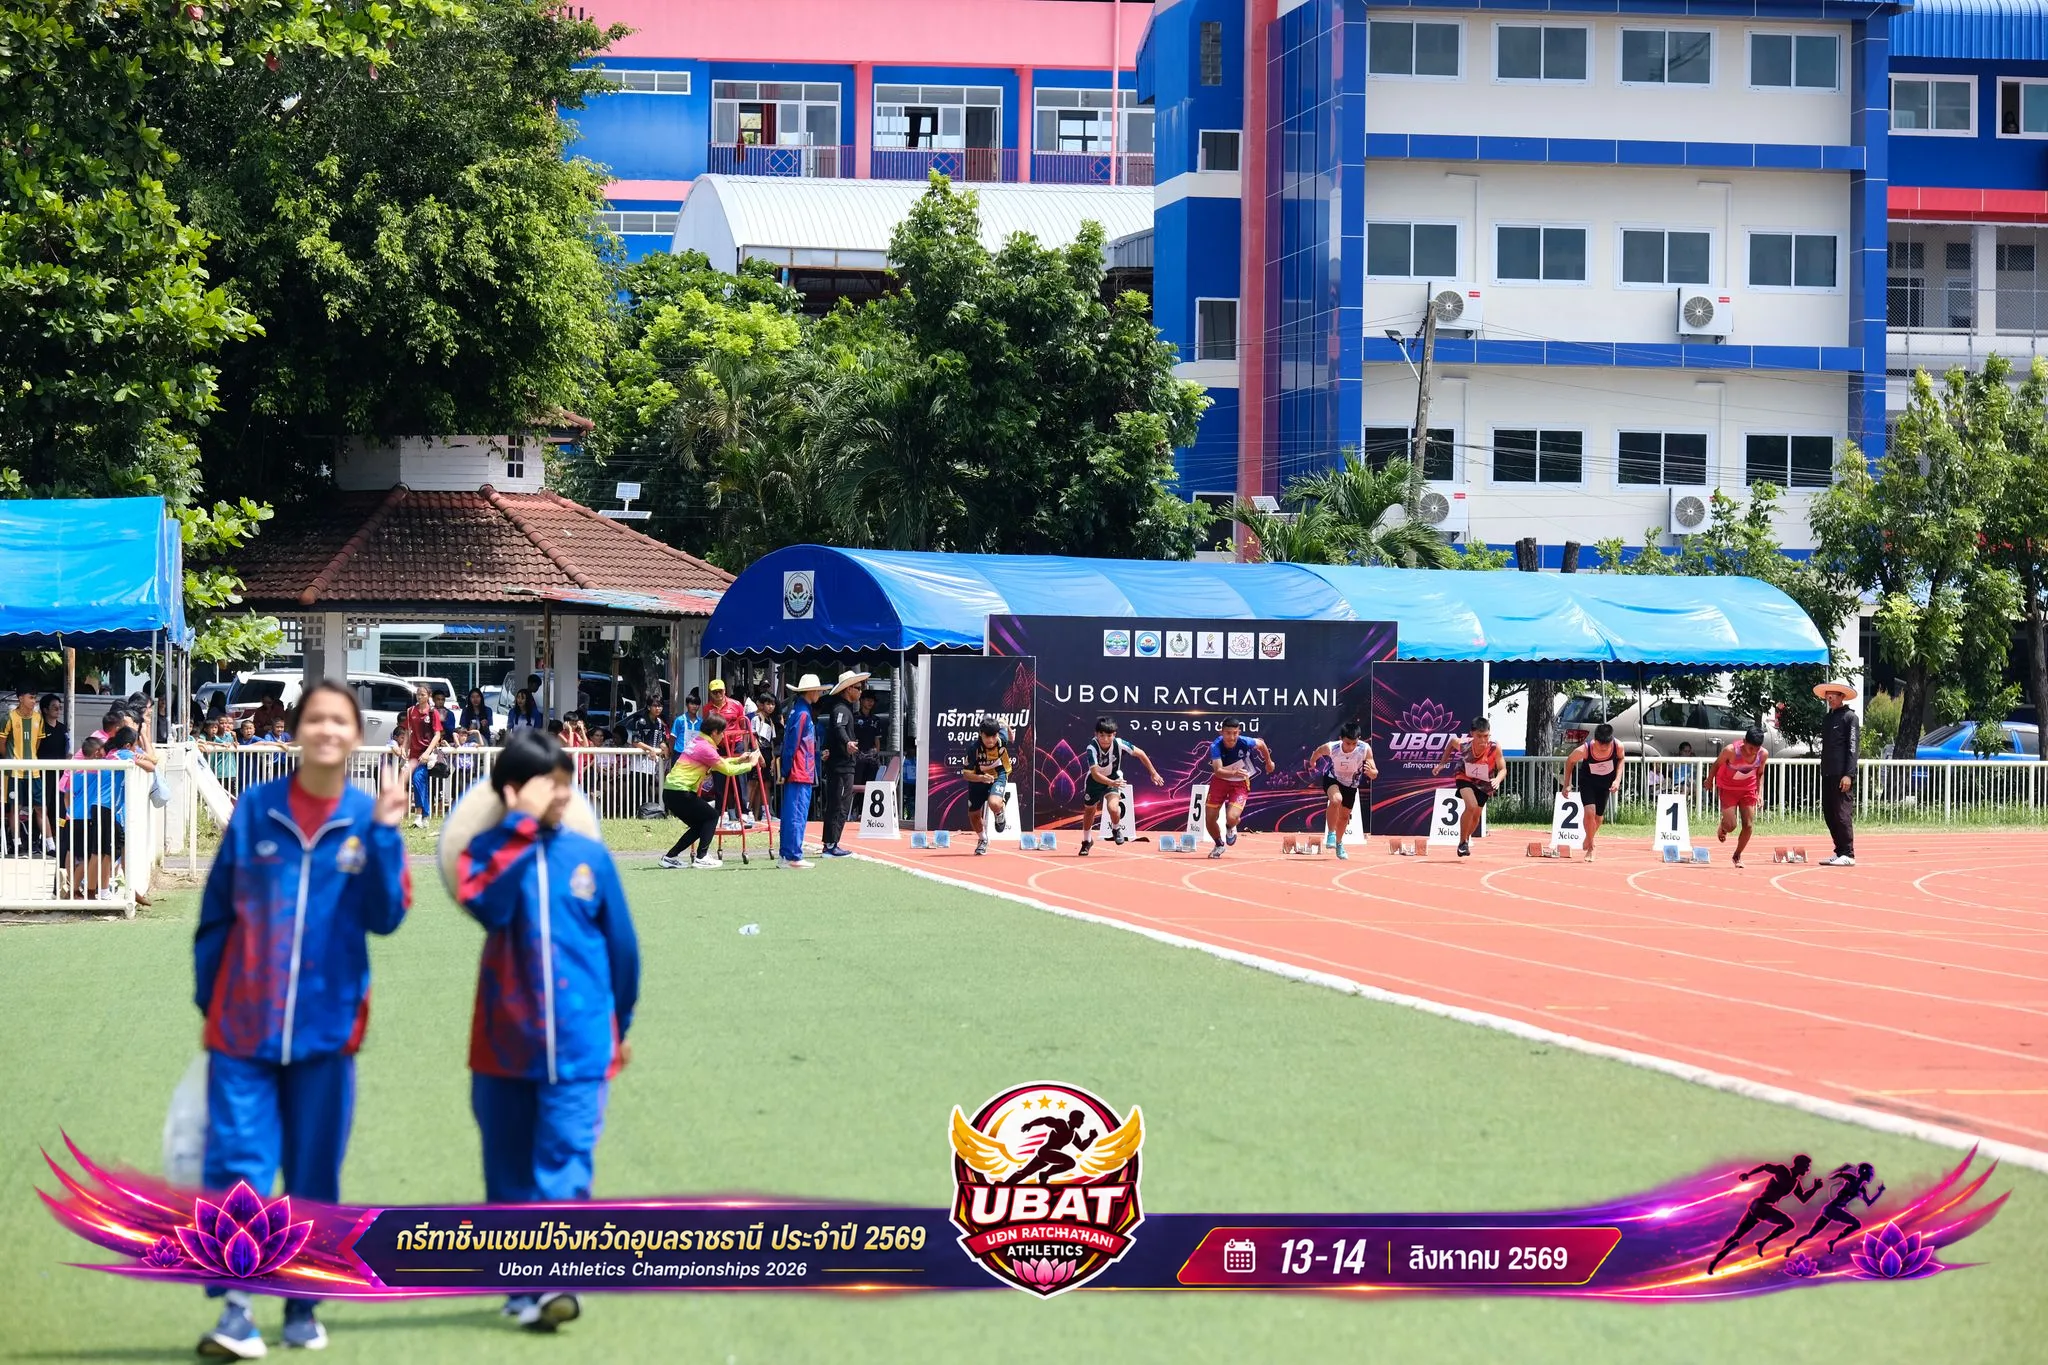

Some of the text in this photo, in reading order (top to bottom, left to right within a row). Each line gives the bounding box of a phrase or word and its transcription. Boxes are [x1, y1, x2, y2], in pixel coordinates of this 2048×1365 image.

[1054, 684, 1338, 706] UBON RATCHATHANI
[870, 789, 885, 817] 8
[1192, 793, 1203, 822] 5
[1441, 797, 1459, 826] 3
[1560, 801, 1579, 829] 2
[1666, 802, 1679, 831] 1
